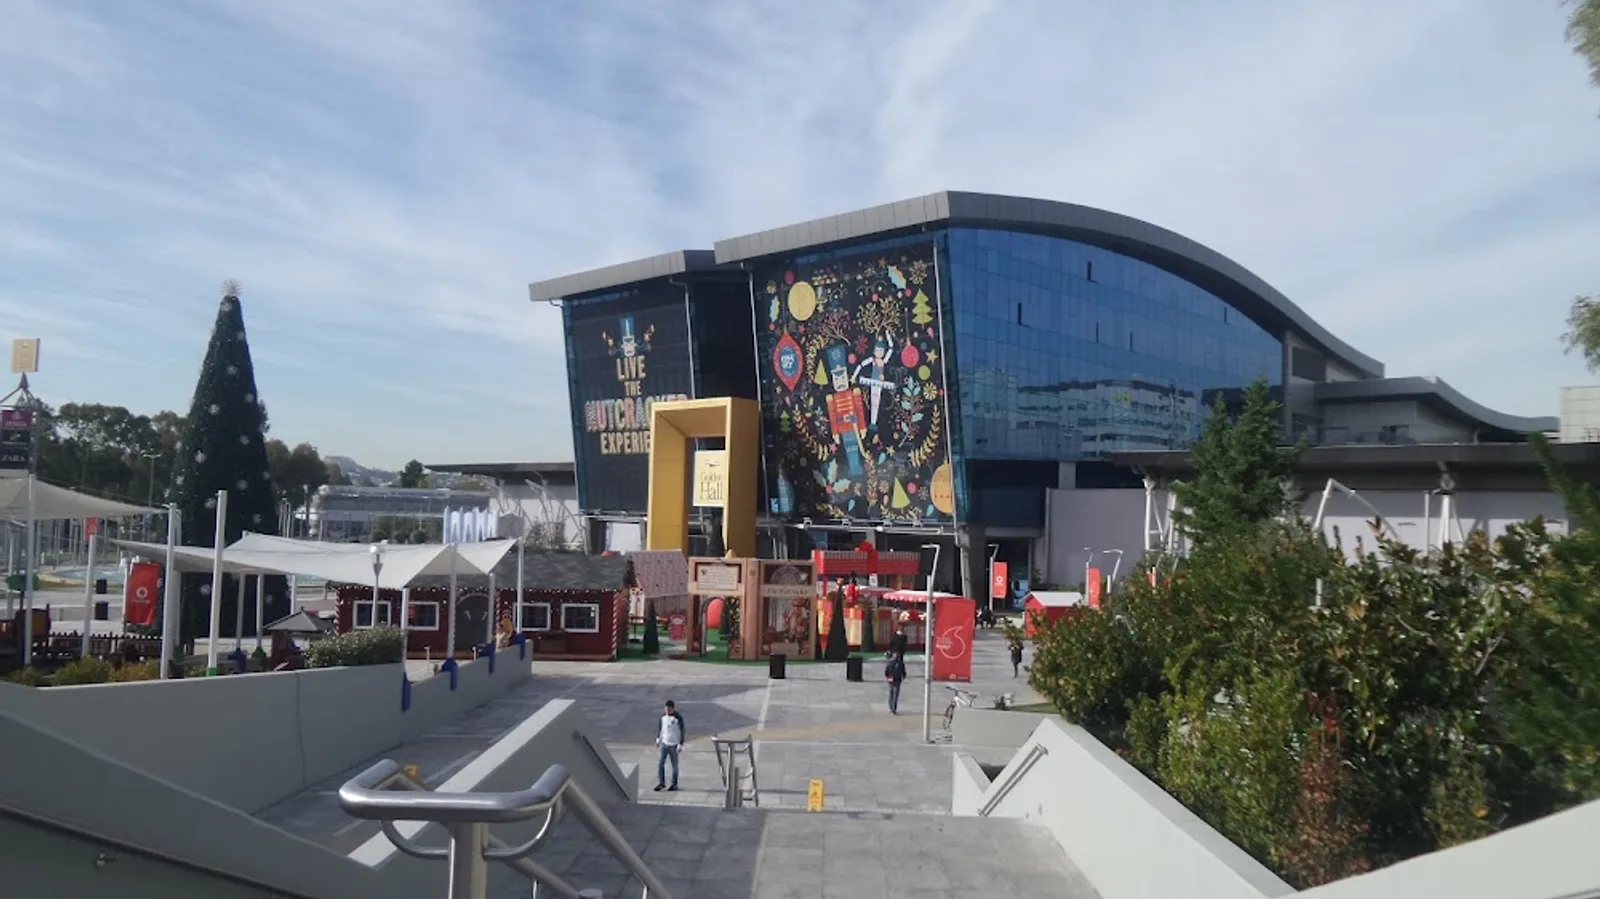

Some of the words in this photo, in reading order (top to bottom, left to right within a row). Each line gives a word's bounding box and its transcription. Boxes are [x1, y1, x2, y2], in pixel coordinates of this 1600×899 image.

[616, 355, 646, 381] LIVE
[624, 380, 642, 396] THE
[601, 430, 651, 455] EXPERIE
[700, 481, 724, 500] Hall
